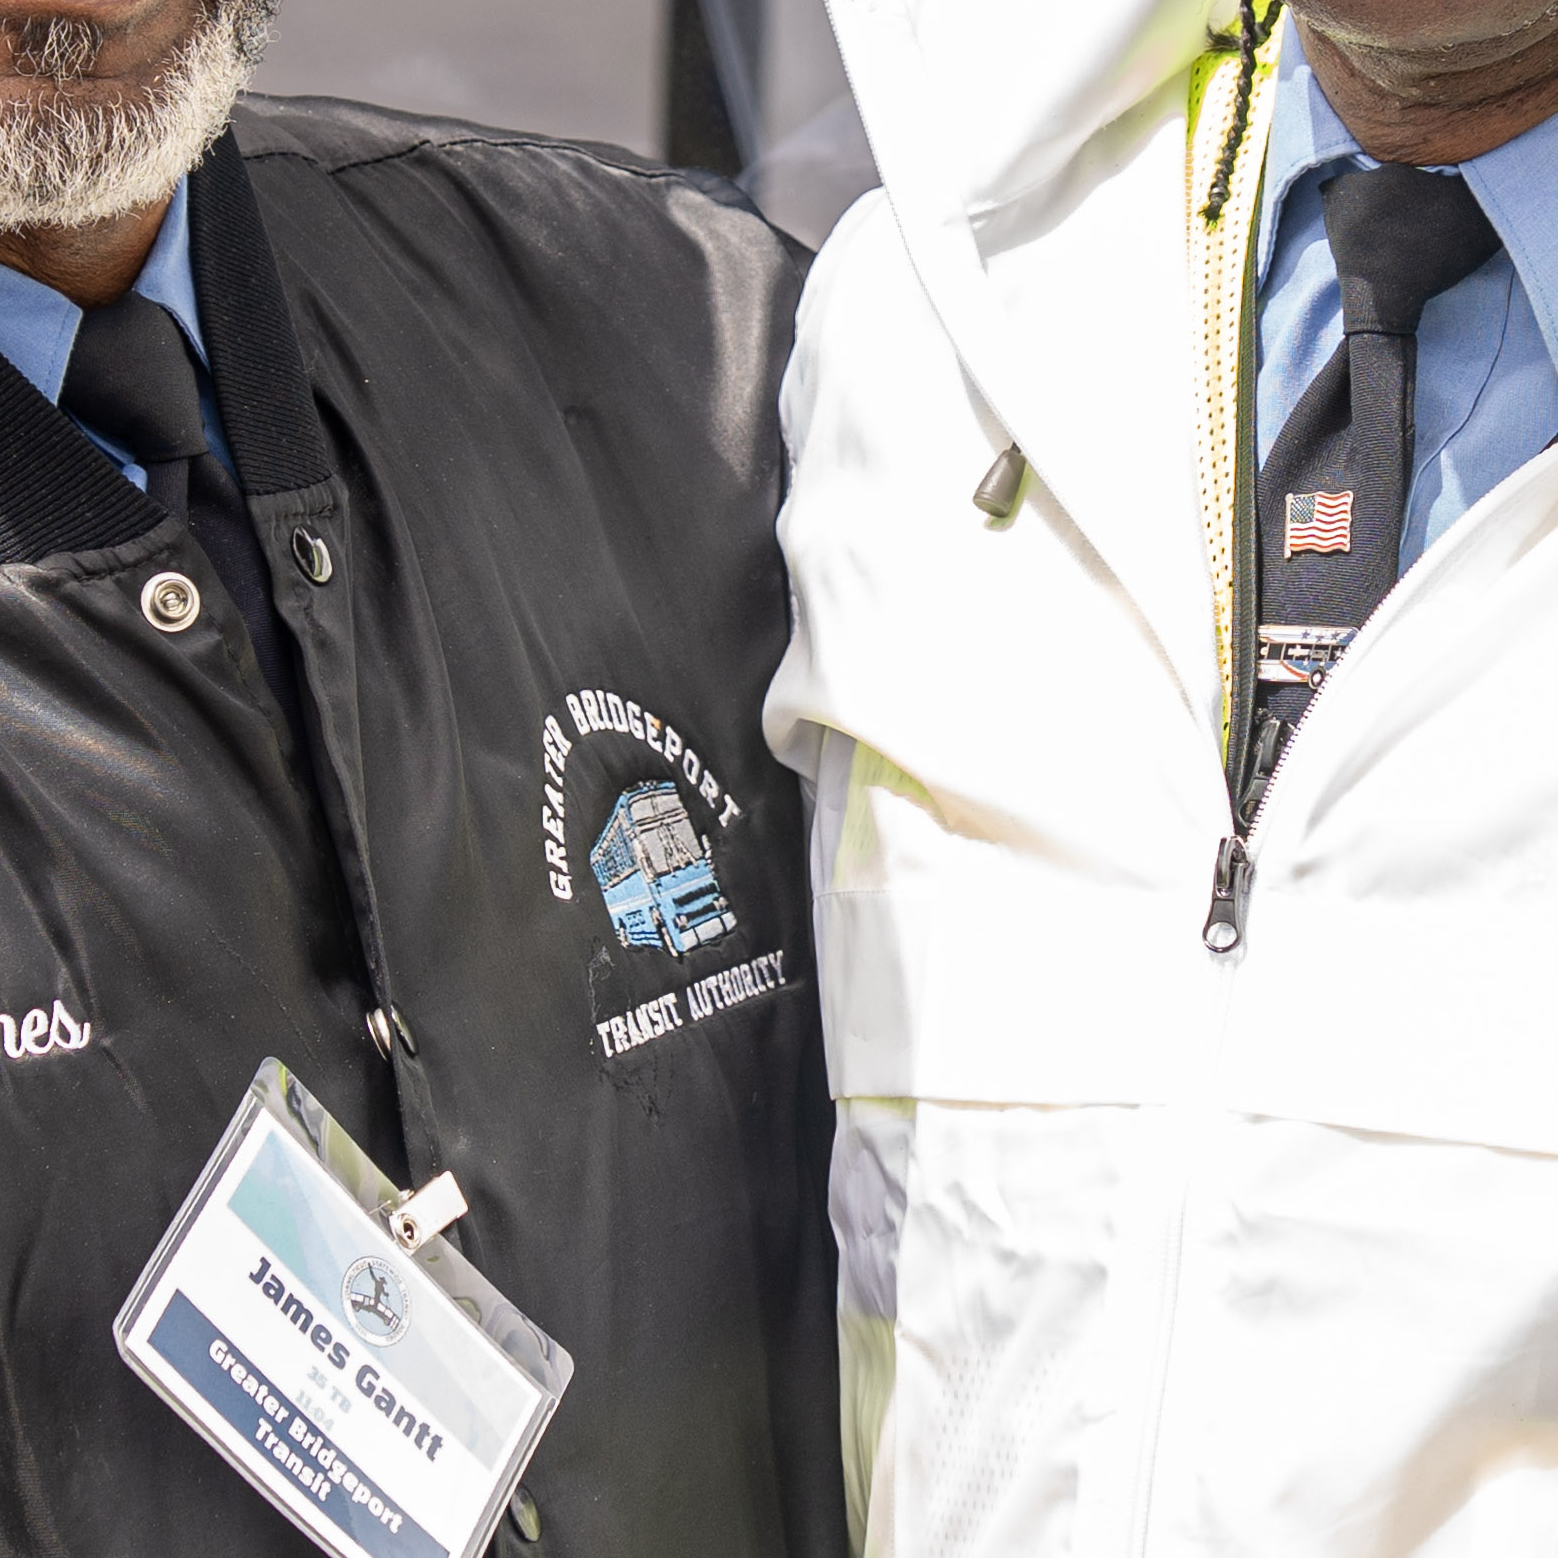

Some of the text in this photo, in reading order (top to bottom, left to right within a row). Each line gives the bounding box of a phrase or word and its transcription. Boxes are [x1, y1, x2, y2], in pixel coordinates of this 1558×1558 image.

[543, 689, 743, 902] GREATER BRIDGEPORT
[596, 949, 787, 1059] TRANSIT AUTHORITY
[208, 1338, 403, 1535] Greater Bridgeport
[248, 1256, 444, 1463] James Gantt
[254, 1417, 332, 1503] Transit
